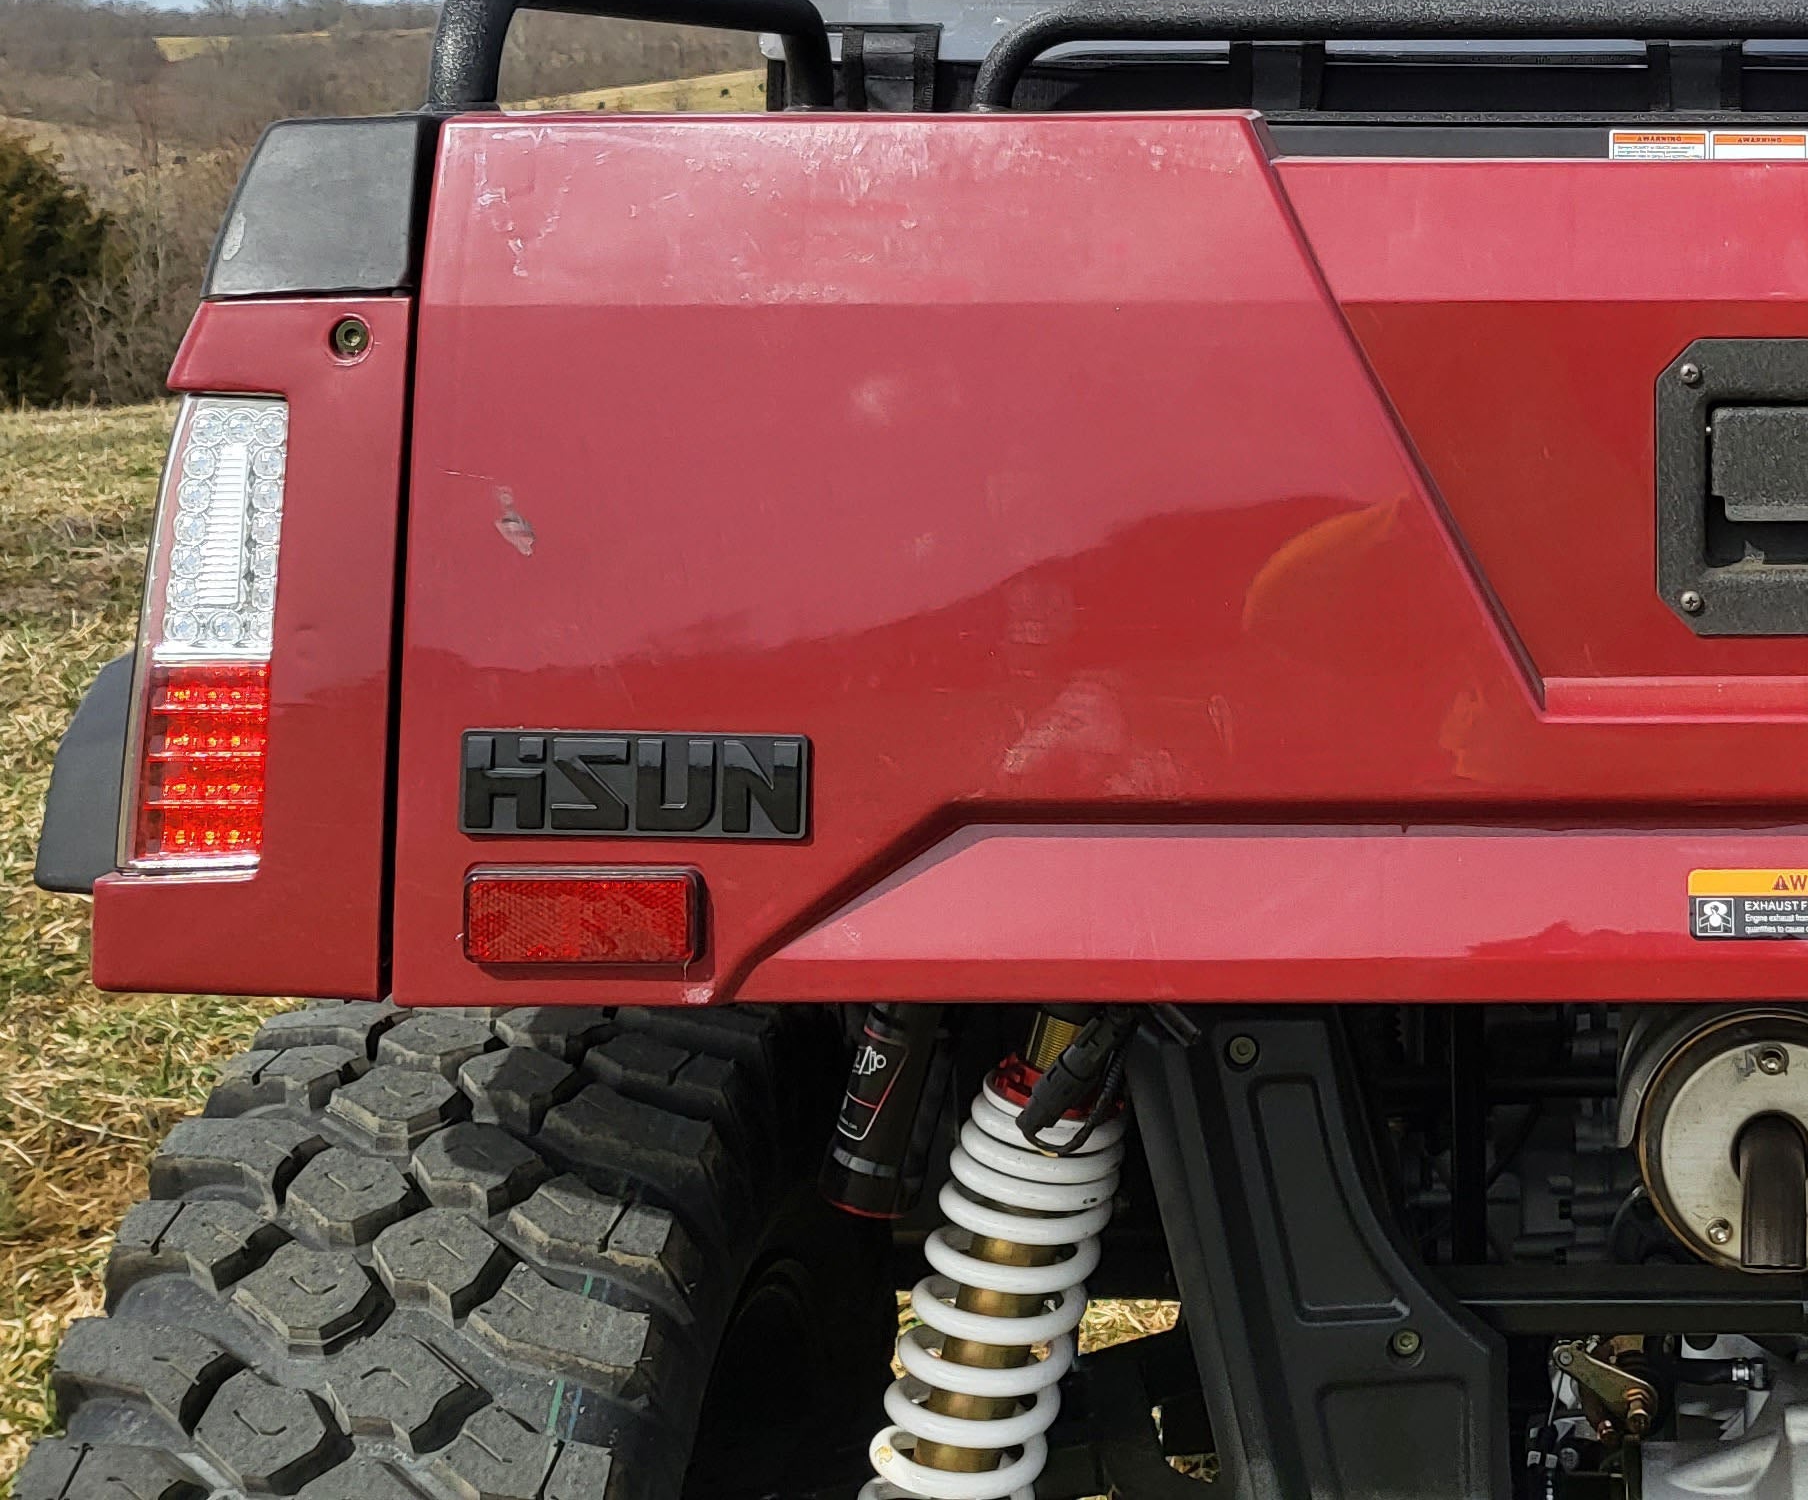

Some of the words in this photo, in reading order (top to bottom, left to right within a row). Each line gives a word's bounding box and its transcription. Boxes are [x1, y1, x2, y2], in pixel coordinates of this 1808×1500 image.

[465, 735, 801, 834] HSUN
[1744, 900, 1799, 911] EXHAUST
[1745, 914, 1768, 924] Engine
[1769, 914, 1795, 922] exhaust
